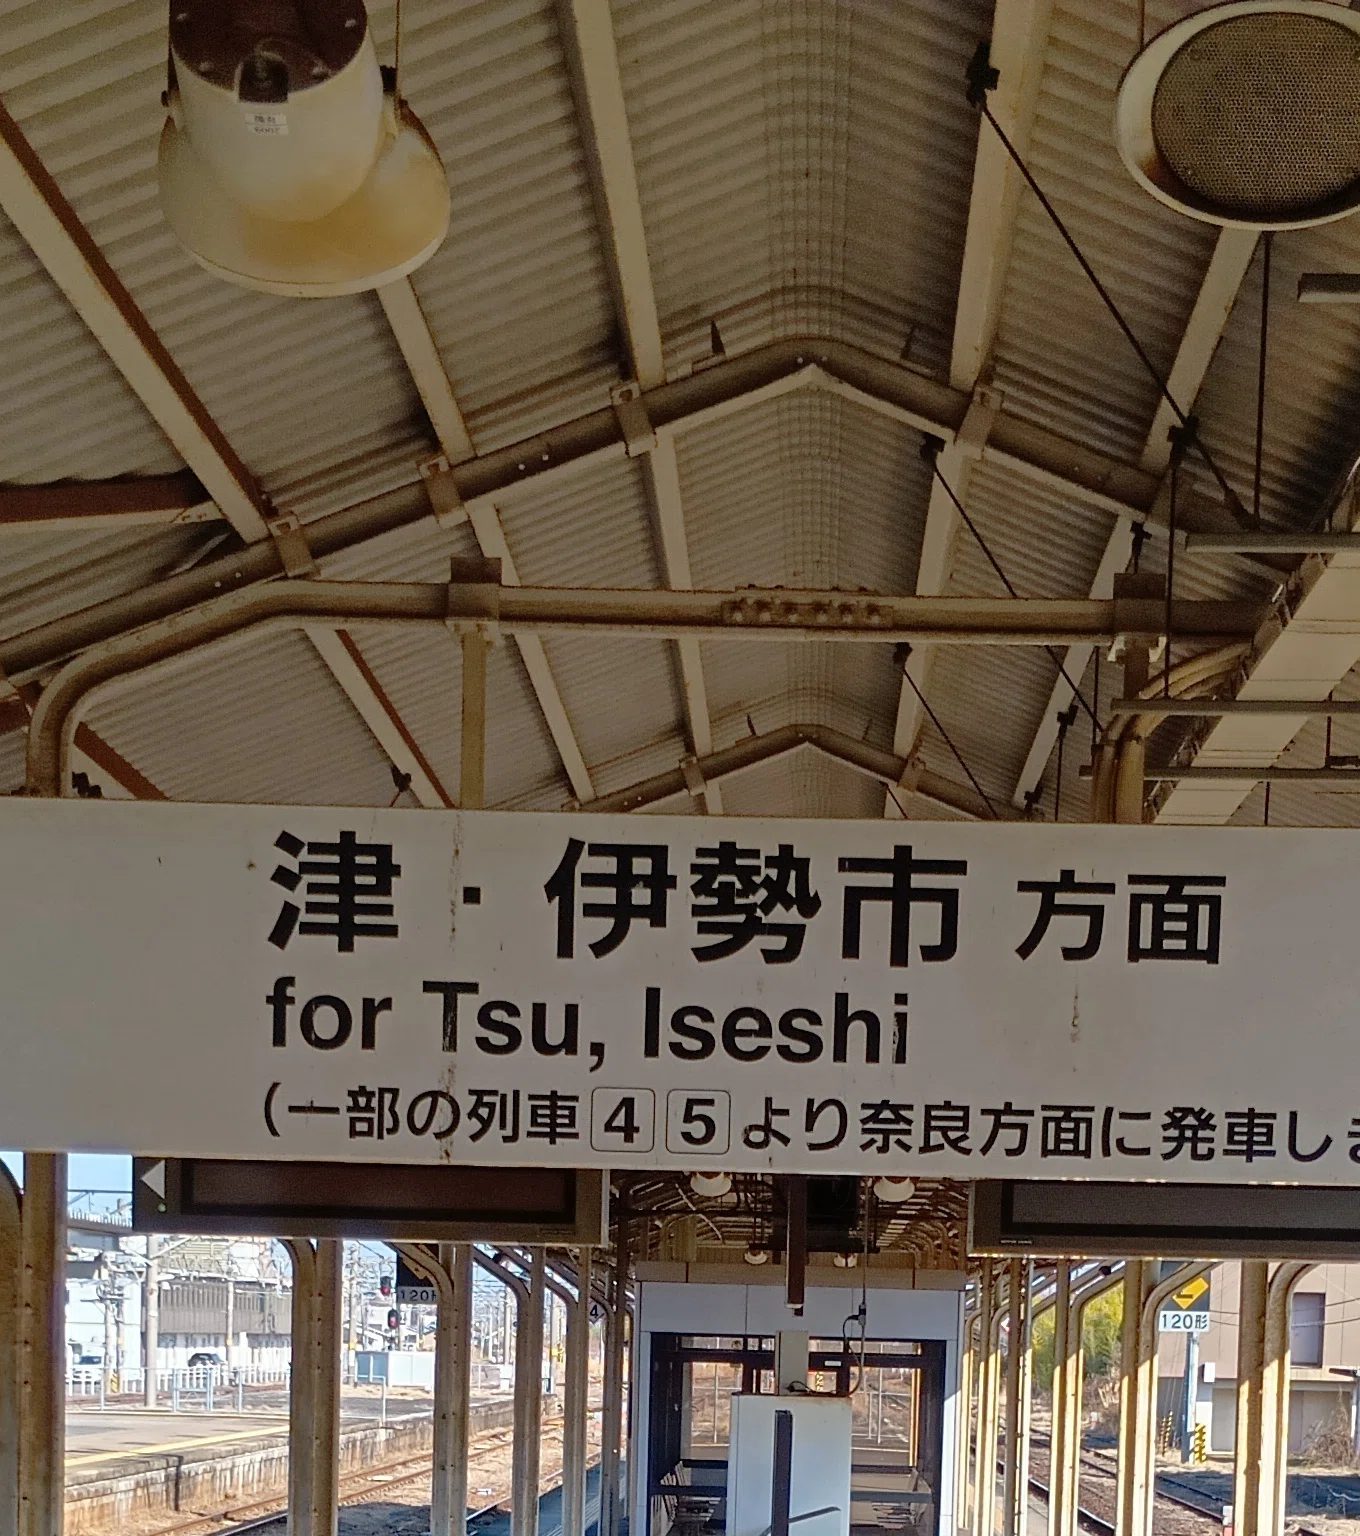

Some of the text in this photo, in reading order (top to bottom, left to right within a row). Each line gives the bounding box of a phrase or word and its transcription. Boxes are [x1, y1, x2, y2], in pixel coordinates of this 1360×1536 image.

[1014, 869, 1228, 965] 方面
[265, 975, 909, 1074] for Tsu, Iseshi
[589, 1304, 599, 1319] 4
[1161, 1313, 1208, 1330] 120形
